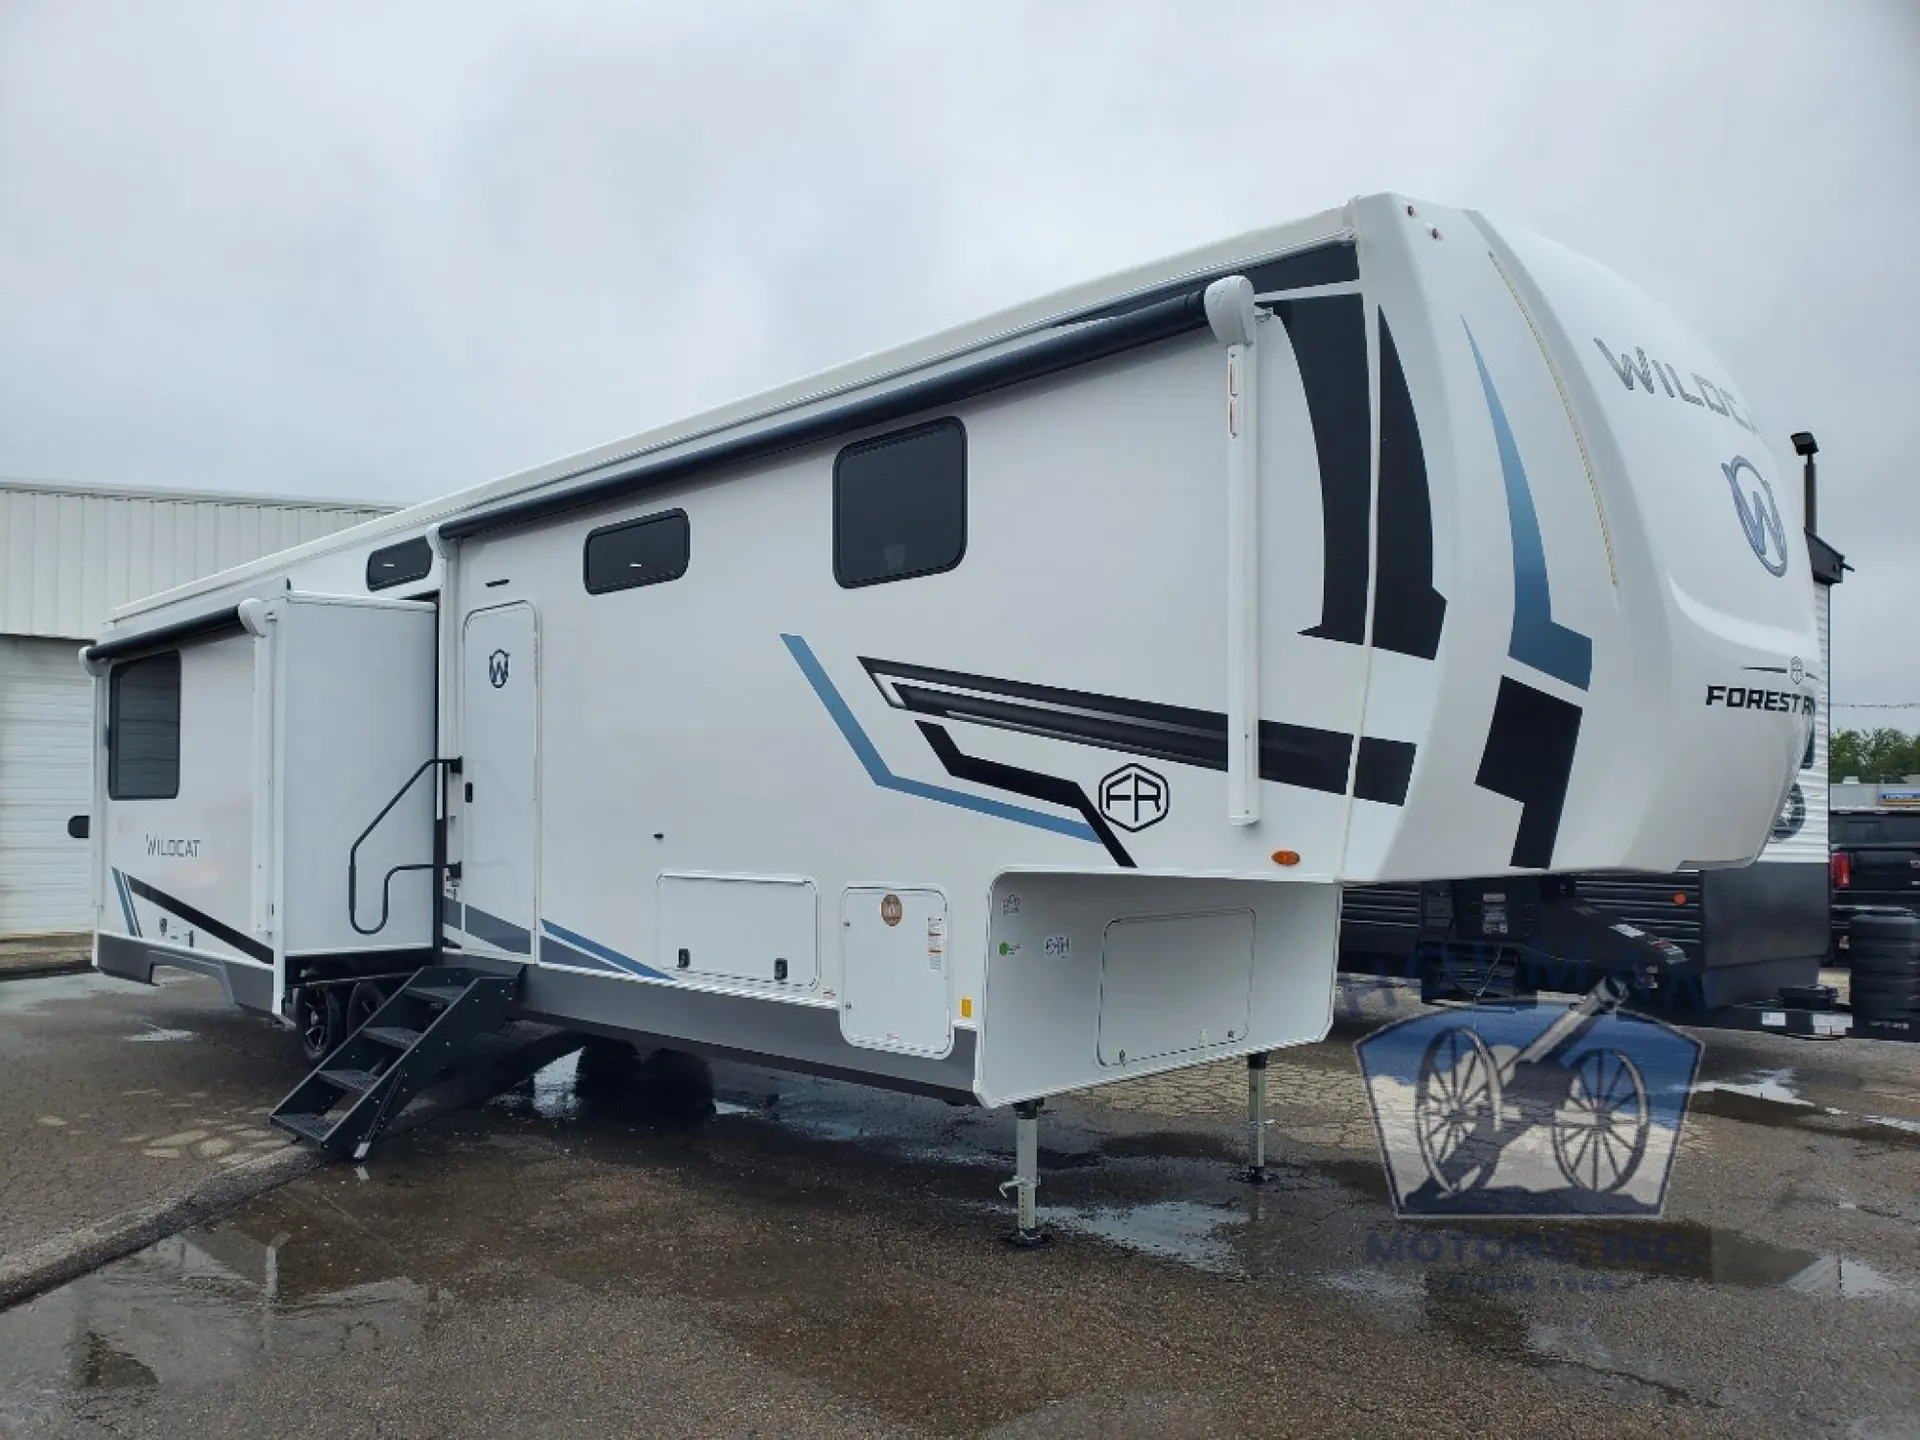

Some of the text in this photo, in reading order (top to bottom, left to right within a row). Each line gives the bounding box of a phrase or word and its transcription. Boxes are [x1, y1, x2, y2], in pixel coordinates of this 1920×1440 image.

[1593, 337, 1754, 434] WILDC
[1706, 685, 1801, 713] FOREST
[146, 833, 201, 858] WILDCAT
